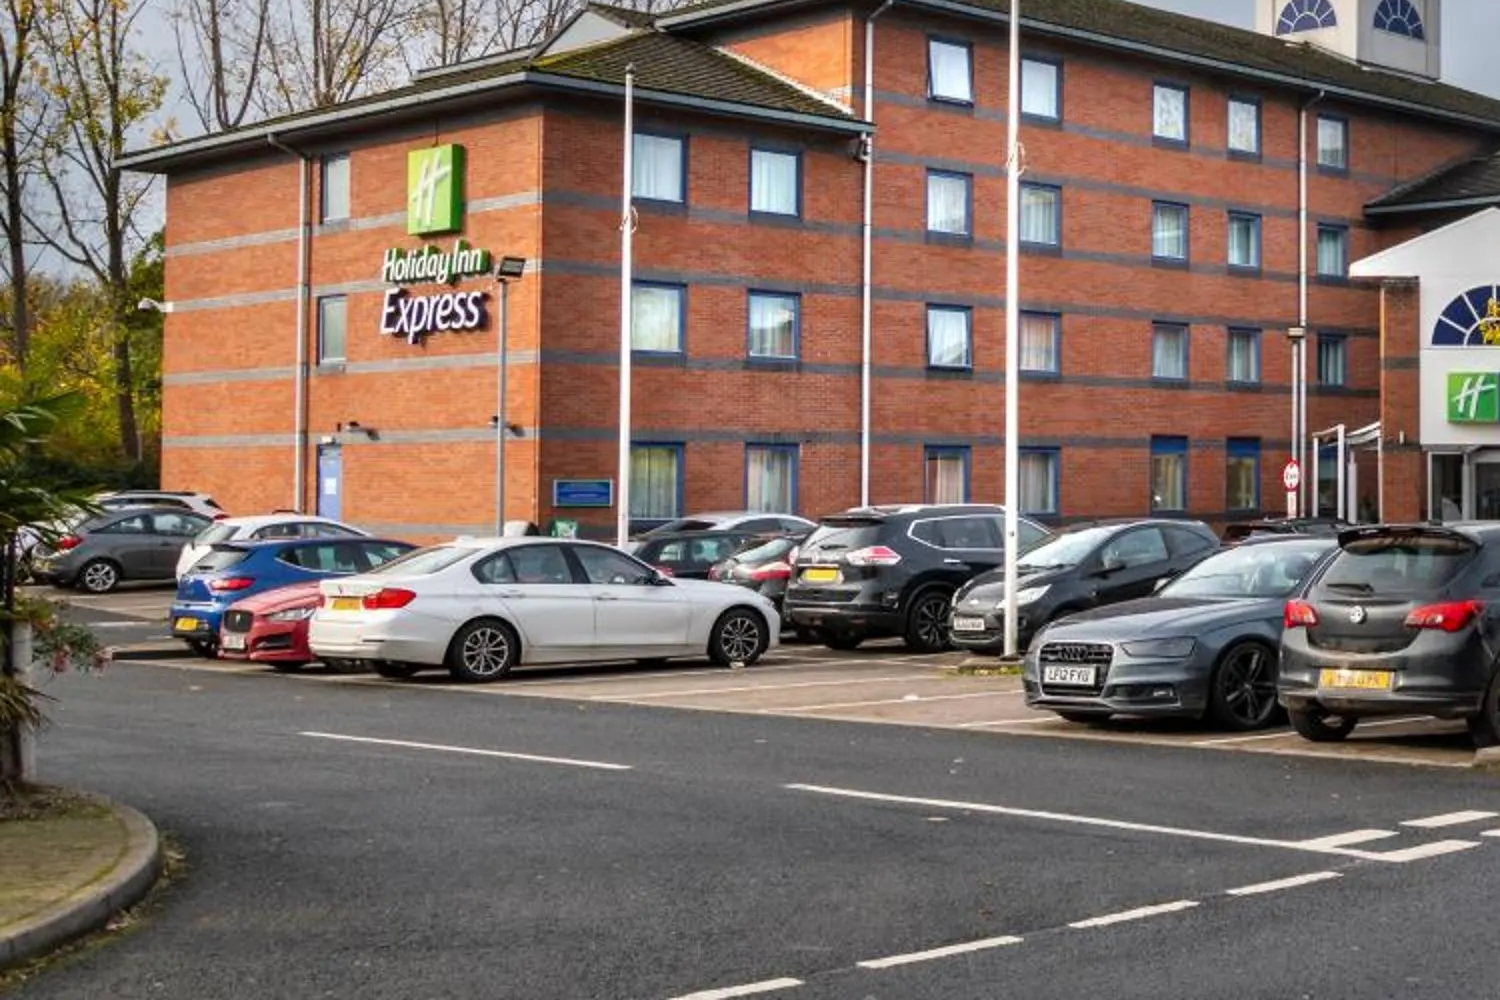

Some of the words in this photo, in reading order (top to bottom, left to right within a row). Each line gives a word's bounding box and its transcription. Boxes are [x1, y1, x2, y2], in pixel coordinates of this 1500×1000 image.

[383, 244, 450, 285] Holiday
[452, 240, 481, 274] Inn
[380, 287, 482, 345] Express
